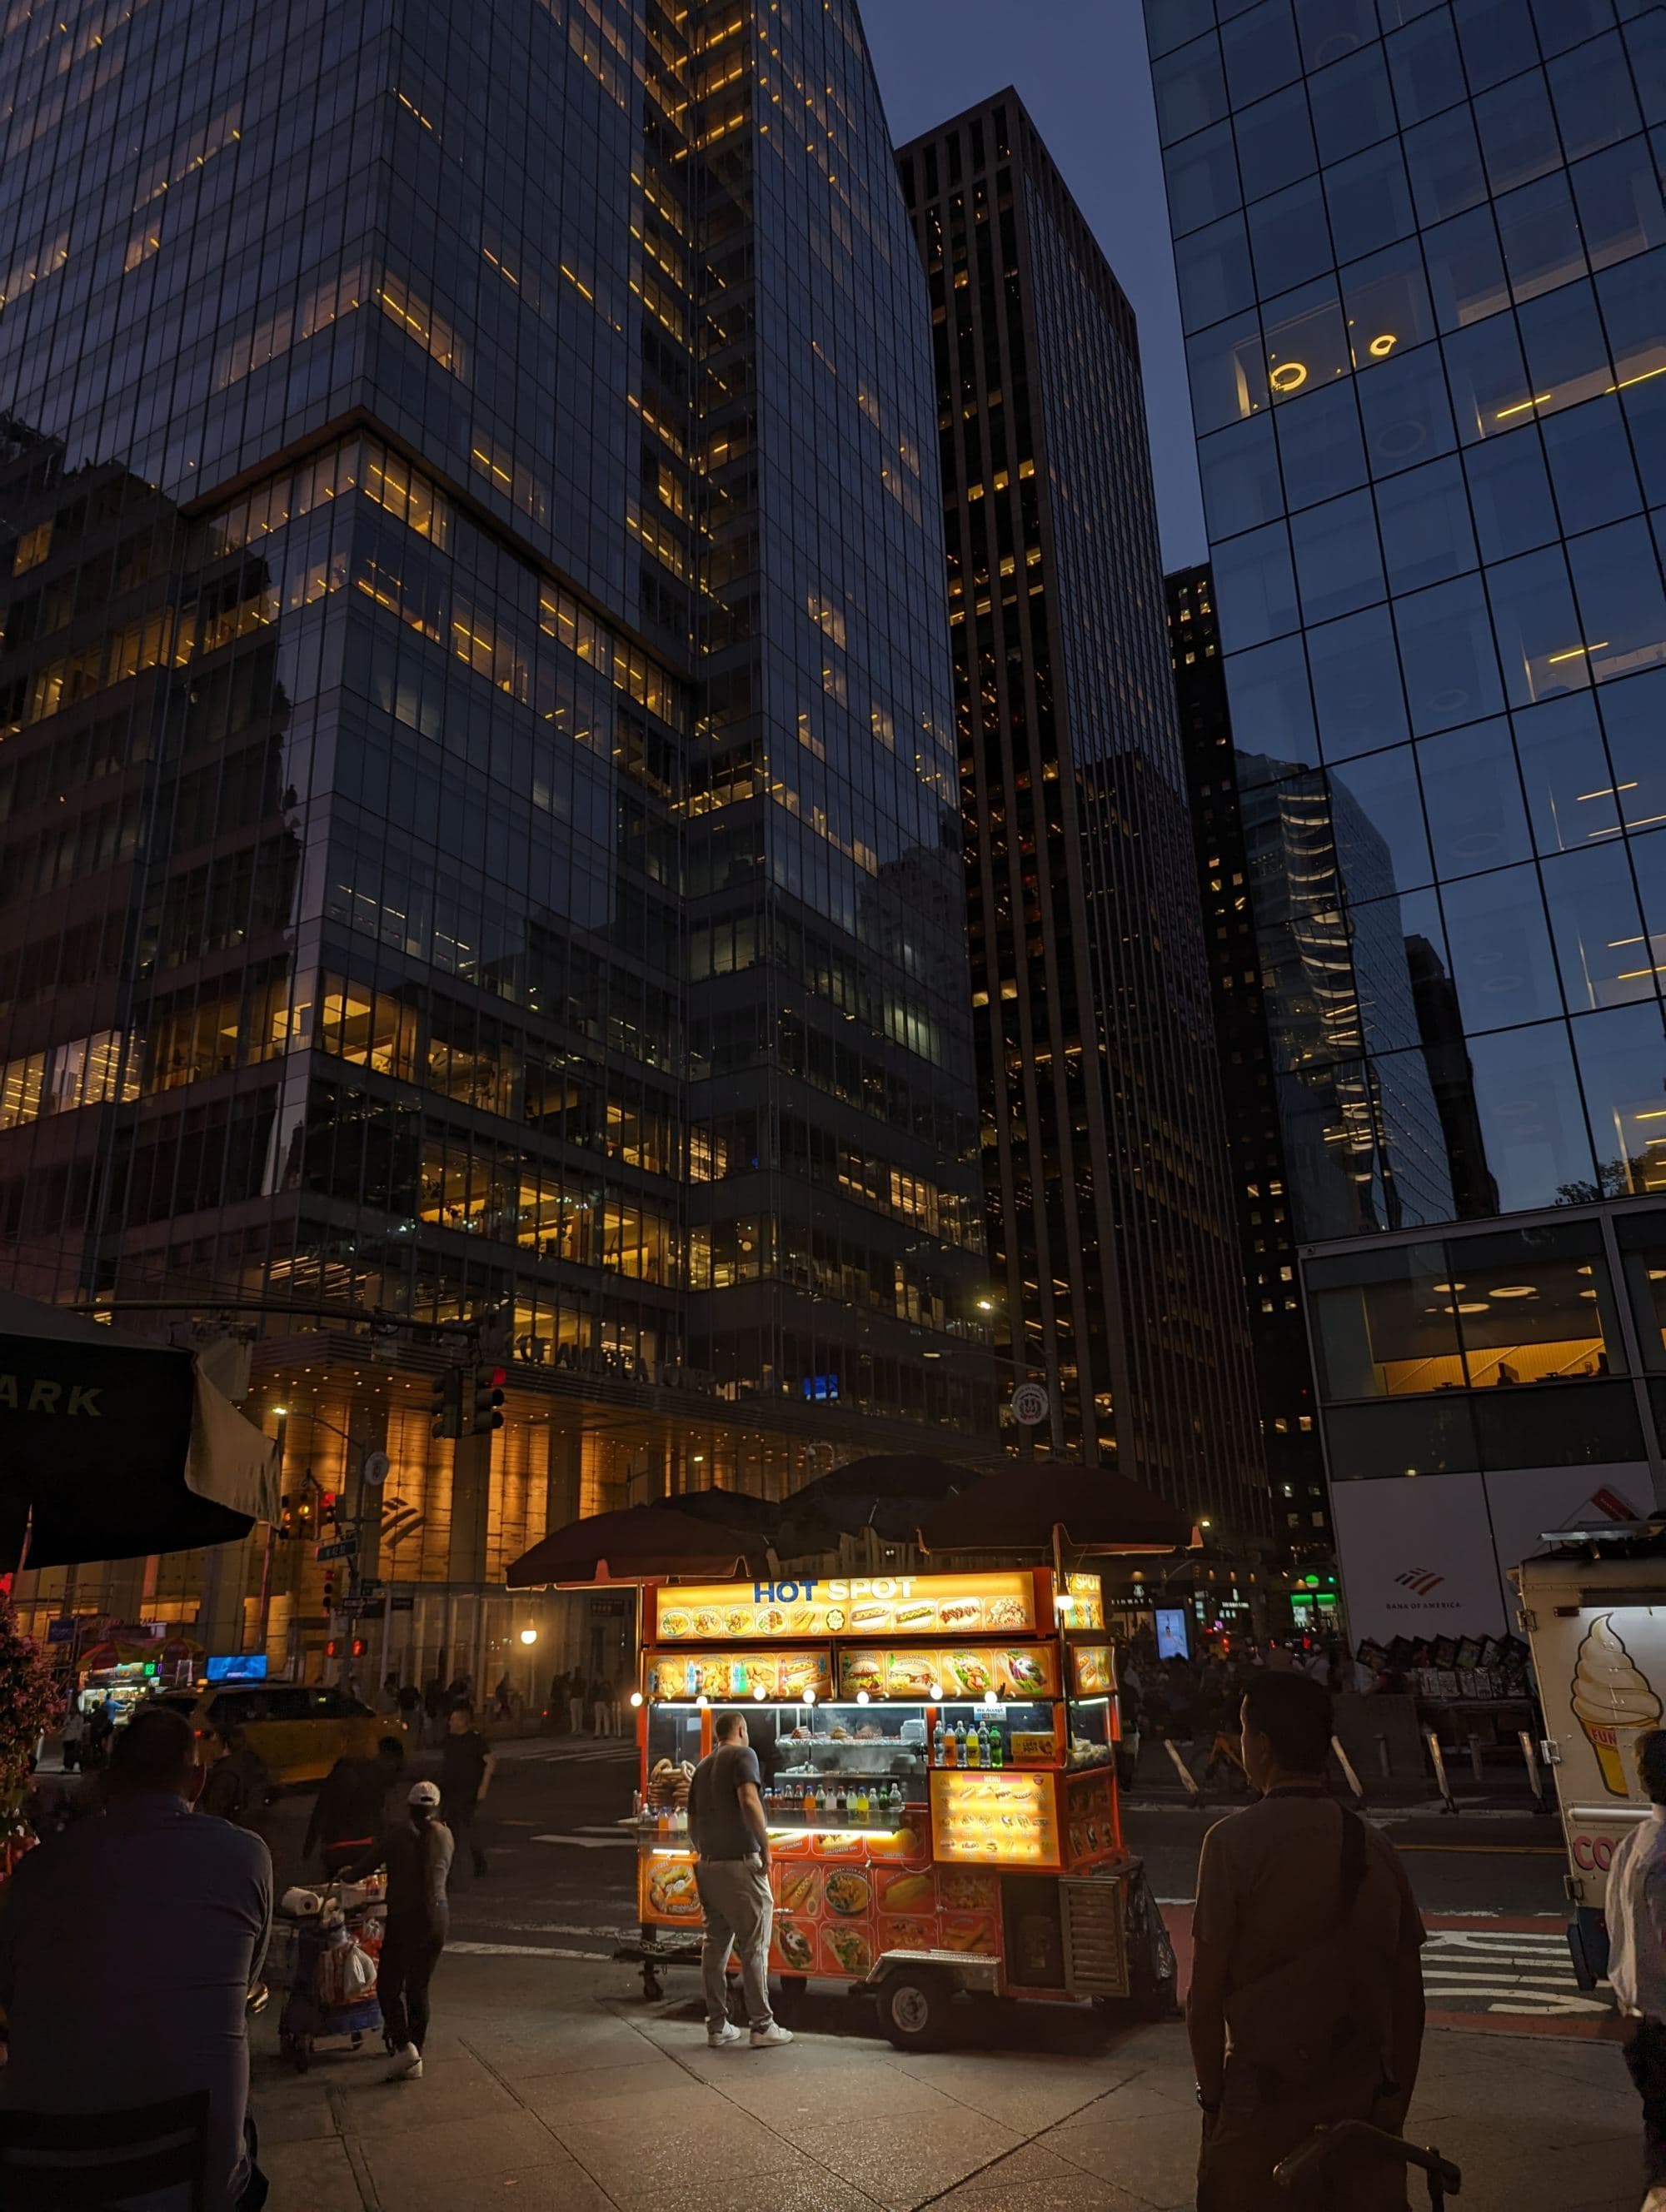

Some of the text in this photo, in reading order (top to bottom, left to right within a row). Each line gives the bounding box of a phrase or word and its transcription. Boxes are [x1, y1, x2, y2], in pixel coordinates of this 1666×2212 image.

[0, 1373, 104, 1416] ARK
[754, 1576, 917, 1603] HOT SPOT
[1076, 1572, 1100, 1590] SPOT
